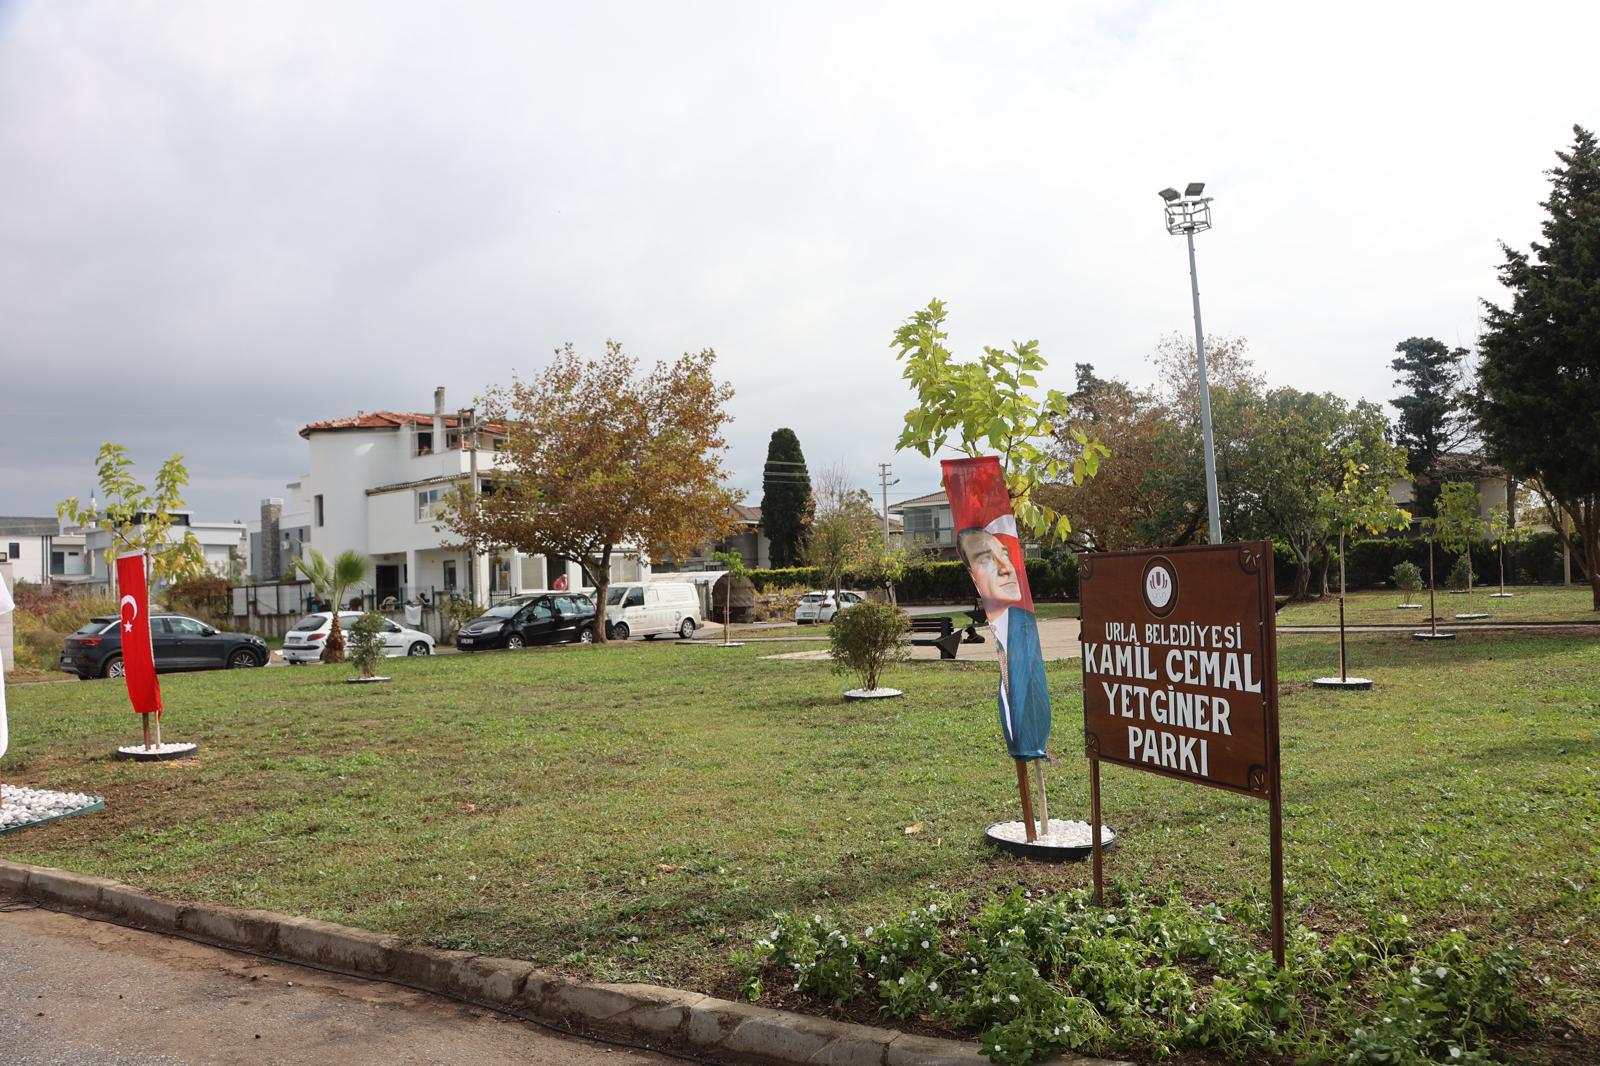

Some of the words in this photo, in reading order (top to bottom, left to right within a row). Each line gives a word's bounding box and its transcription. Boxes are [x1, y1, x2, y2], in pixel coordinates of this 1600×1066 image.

[1105, 622, 1138, 642] URLA
[1145, 621, 1242, 649] BELEDİYESİ
[1084, 642, 1157, 680] KAMİL
[1165, 649, 1261, 694] CEMAL
[1102, 681, 1232, 736] YETGİNER
[1127, 725, 1209, 777] PARKI
